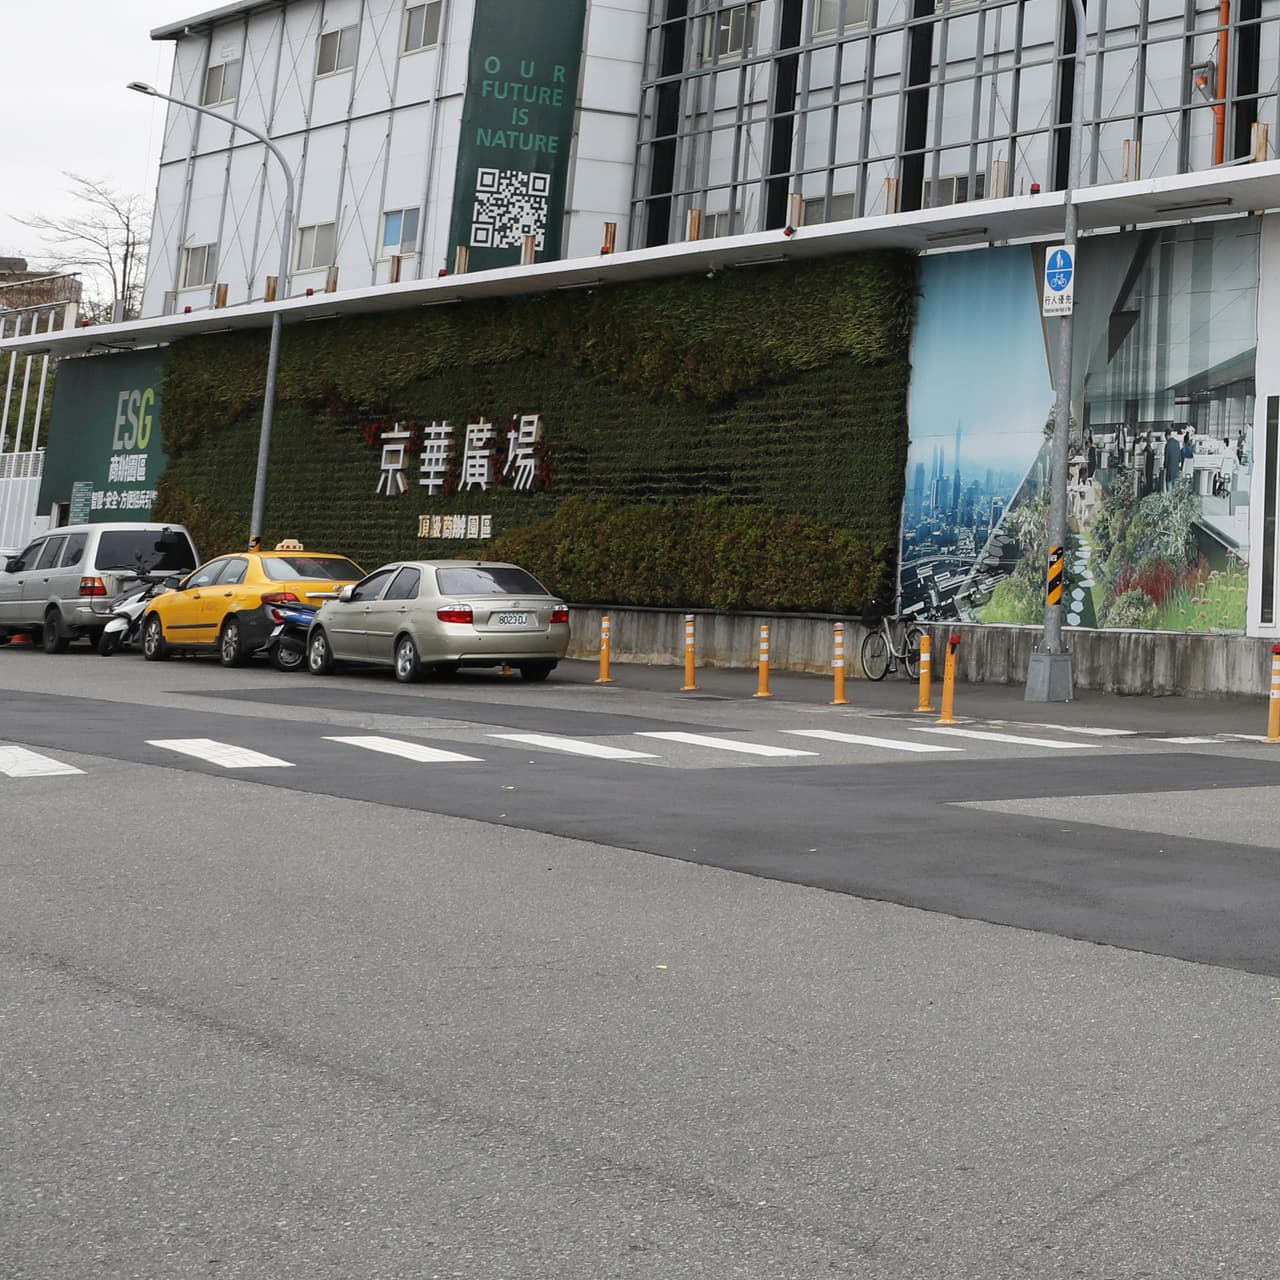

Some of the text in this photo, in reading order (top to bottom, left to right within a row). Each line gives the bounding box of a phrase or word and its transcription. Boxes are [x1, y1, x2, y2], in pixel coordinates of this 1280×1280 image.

[484, 55, 566, 83] OUR
[481, 80, 564, 107] FUTURE
[511, 107, 529, 126] IS
[476, 127, 559, 155] NATURE
[112, 387, 155, 451] ESG
[376, 413, 541, 496] 京華廣場
[417, 514, 492, 539] 頂級商辦園區
